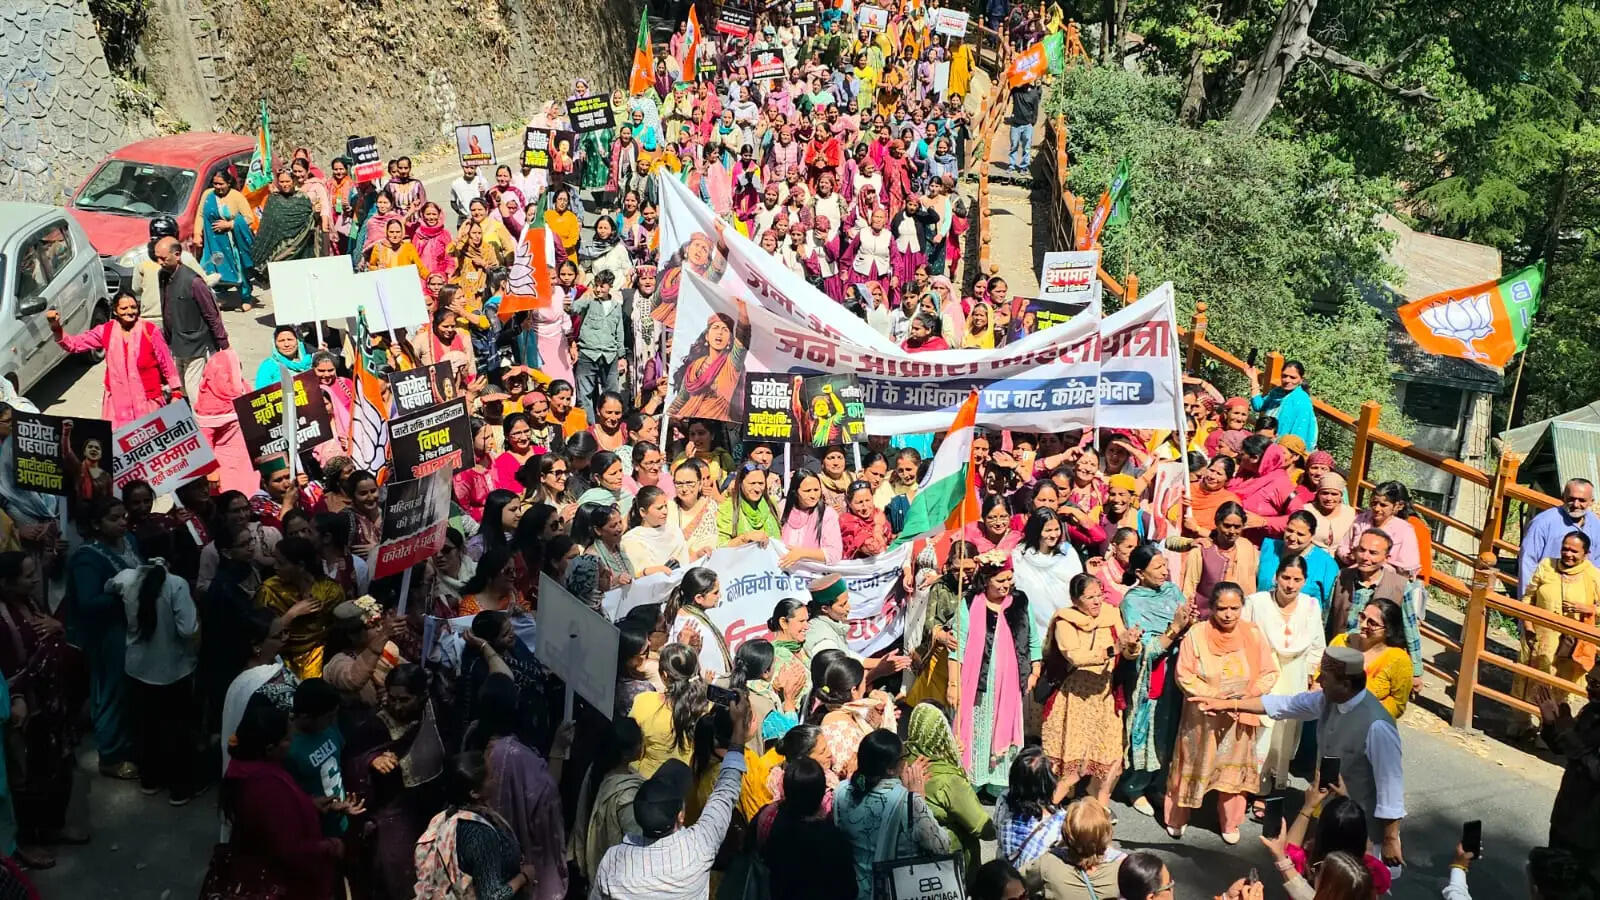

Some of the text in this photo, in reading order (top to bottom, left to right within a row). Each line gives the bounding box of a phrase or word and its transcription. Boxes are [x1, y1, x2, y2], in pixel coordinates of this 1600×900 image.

[395, 374, 428, 397] कांग्रेस
[750, 378, 789, 396] कांग्रेस
[399, 389, 433, 410] पहचान
[750, 394, 791, 409] पहचान
[984, 389, 1009, 409] पर
[1012, 389, 1047, 410] वार,
[17, 418, 54, 441] कांग्रेस
[416, 427, 451, 452] विपक्ष
[747, 423, 792, 437] अपमान
[17, 435, 59, 457] पहचान
[123, 440, 154, 466] आदत
[146, 434, 201, 473] सम्मान
[17, 468, 63, 489] अपमान
